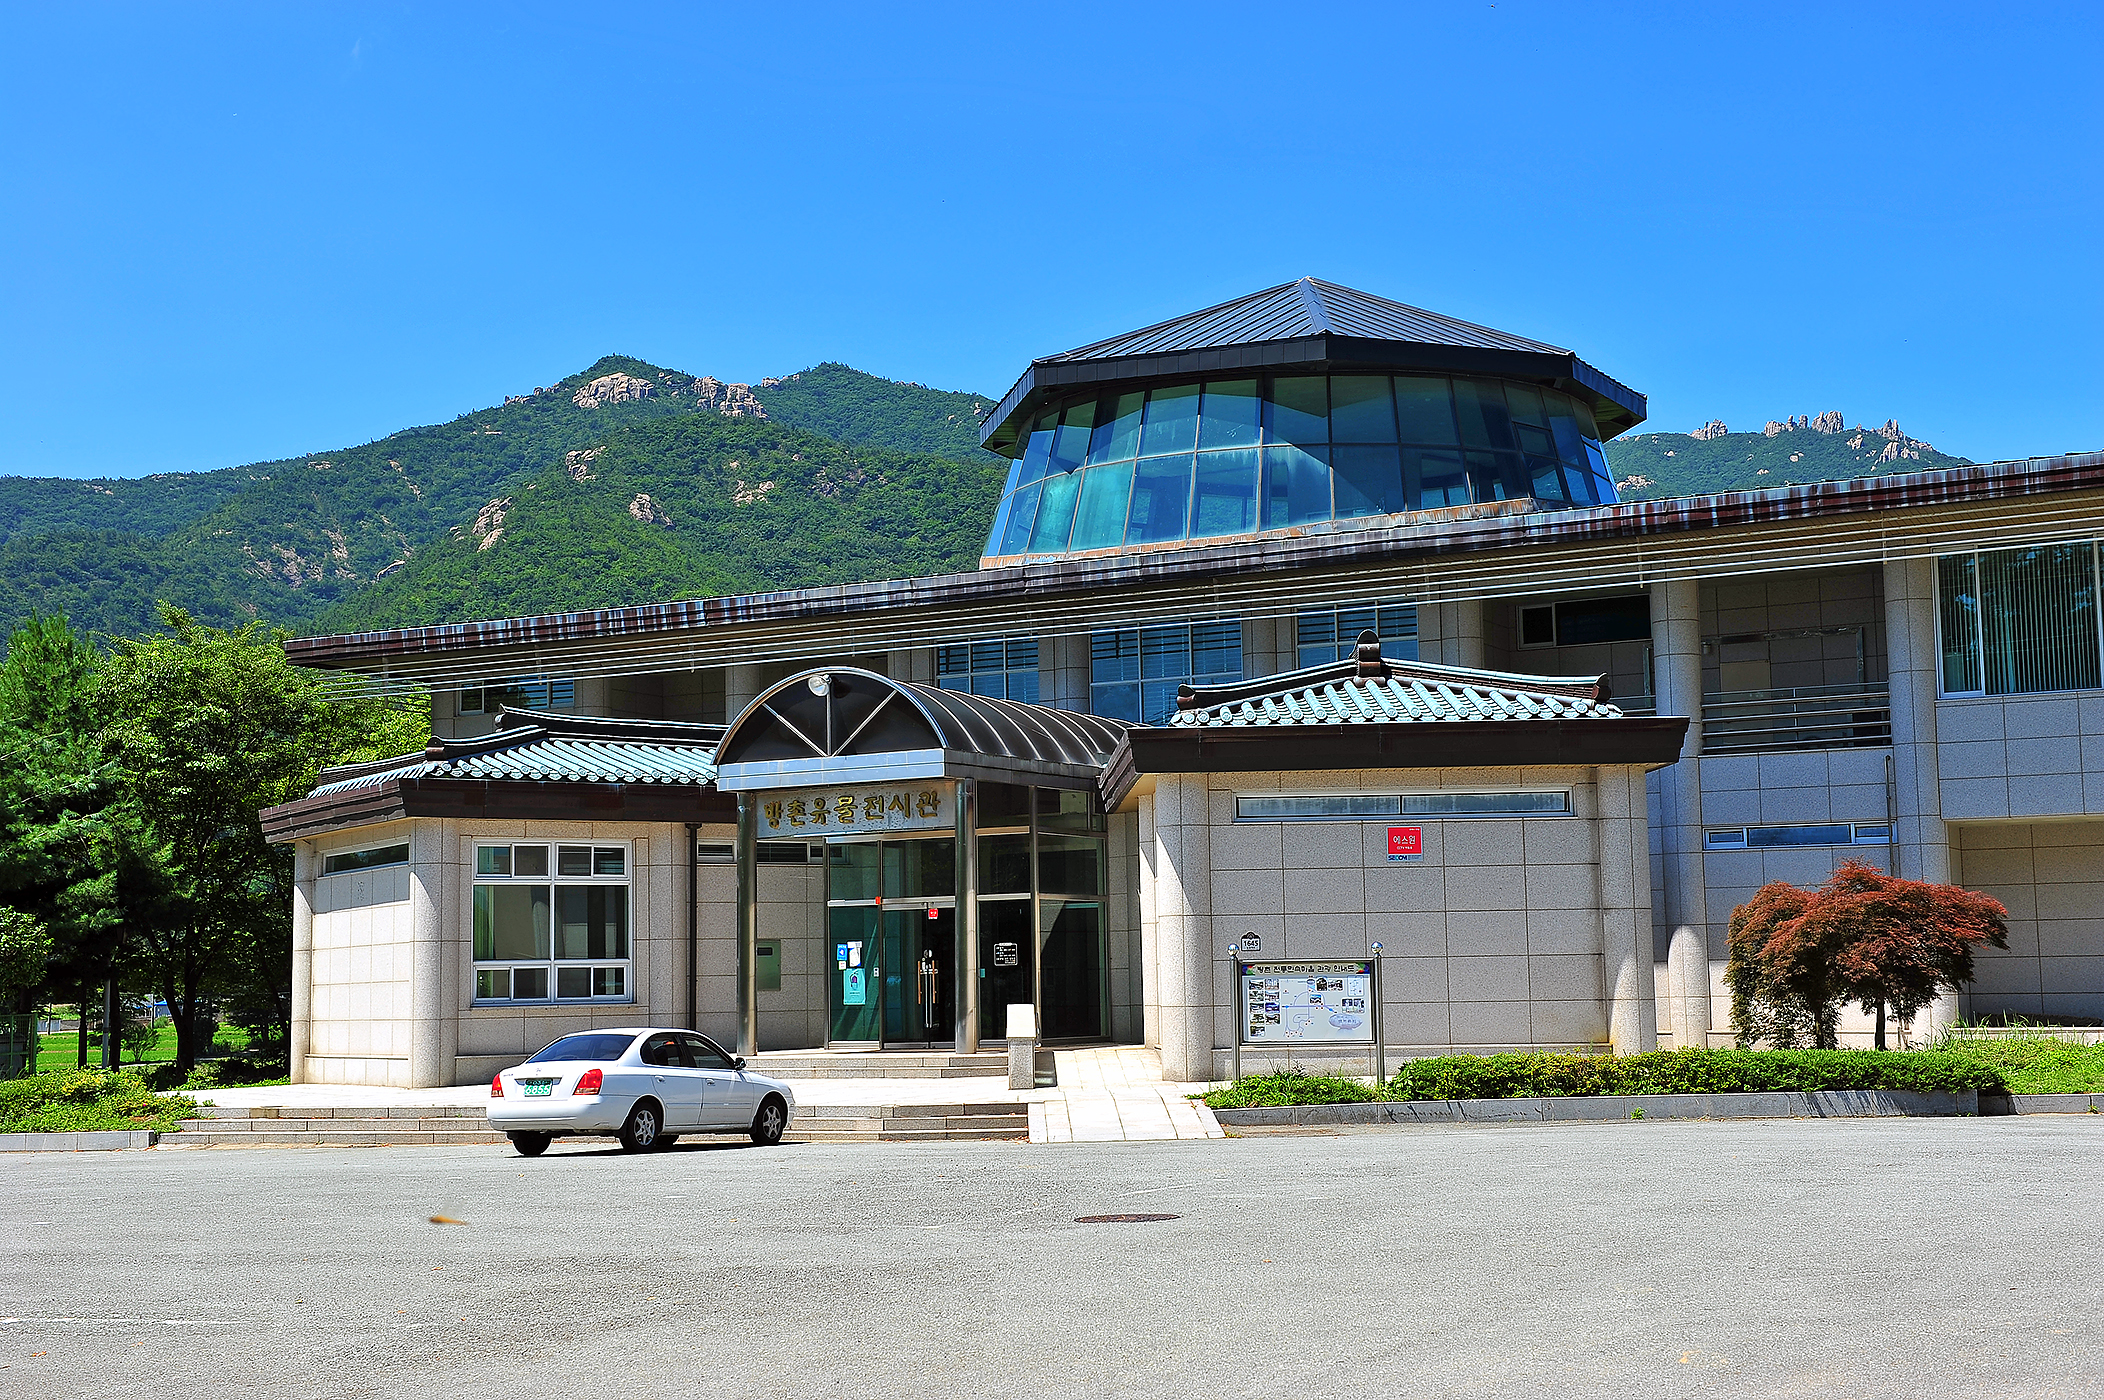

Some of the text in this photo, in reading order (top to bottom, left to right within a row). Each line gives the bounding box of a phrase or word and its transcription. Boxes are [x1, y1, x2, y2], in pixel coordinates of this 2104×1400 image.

[763, 790, 942, 830] 방촌유물전시관
[1392, 834, 1416, 845] 에스원
[525, 1085, 550, 1095] 6855
